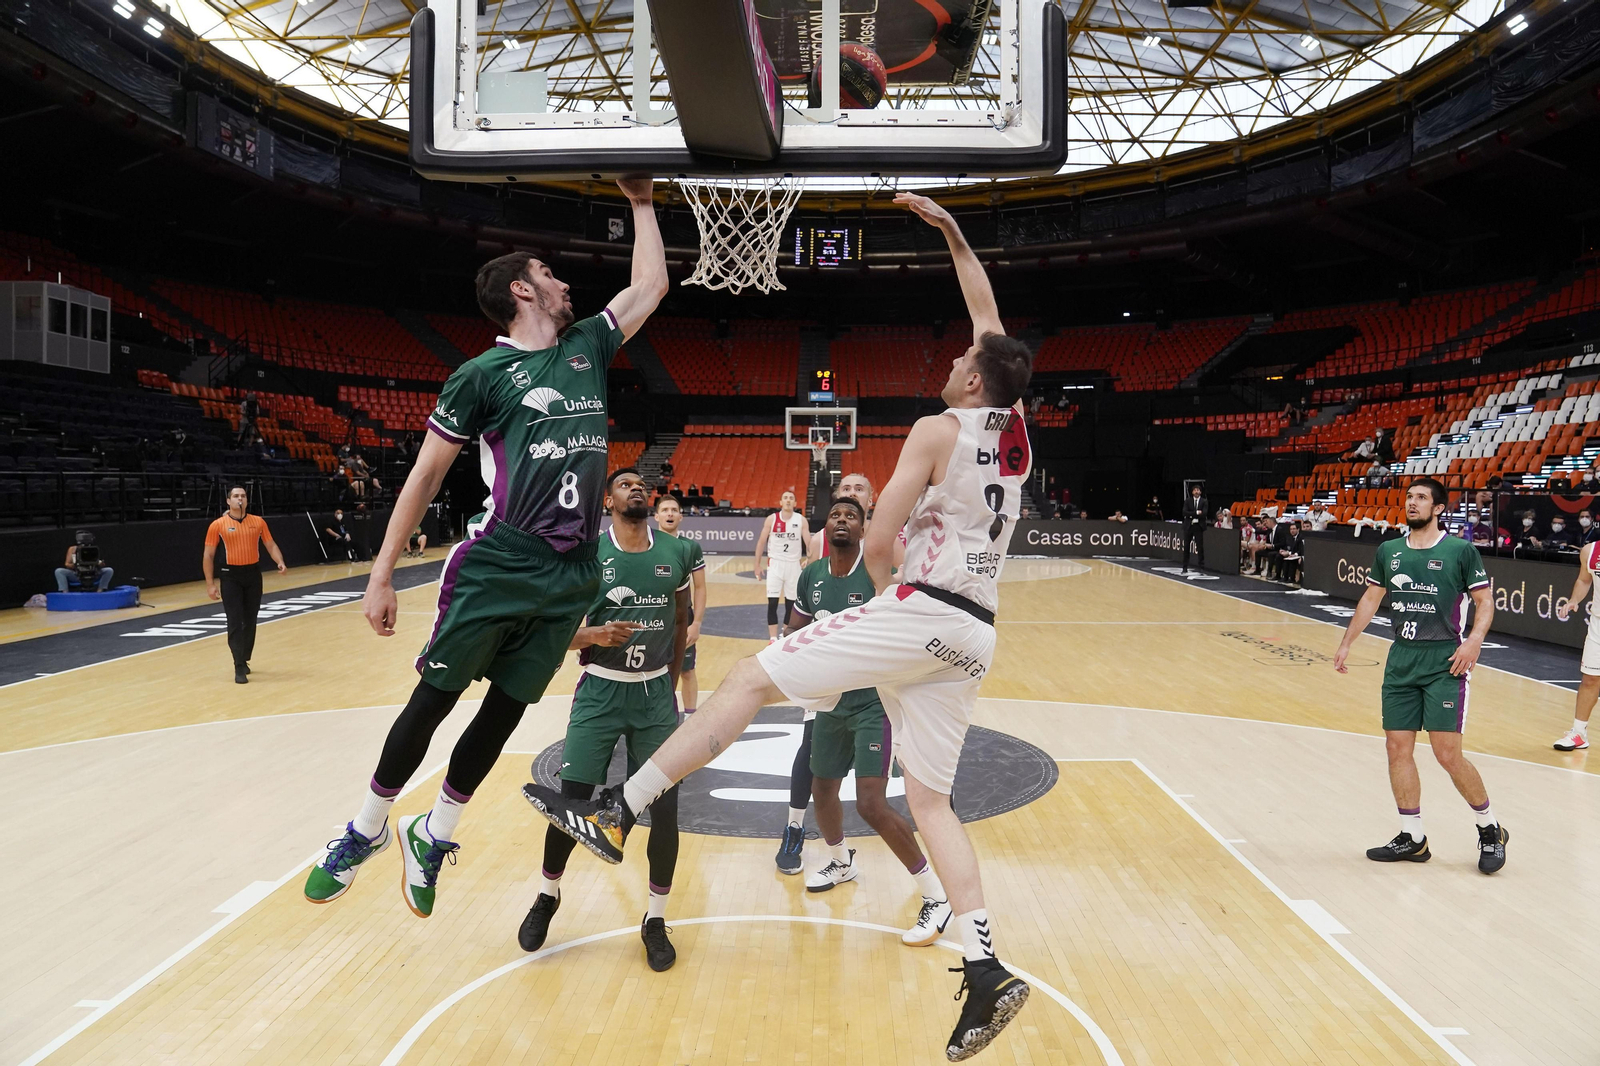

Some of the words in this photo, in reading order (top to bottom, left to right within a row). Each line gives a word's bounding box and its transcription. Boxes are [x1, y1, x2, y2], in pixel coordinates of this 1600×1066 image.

[796, 19, 809, 43] FINAL
[799, 46, 810, 62] FASE
[1583, 344, 1594, 353] 113
[821, 379, 830, 391] 6
[984, 411, 1020, 433] CRUZ
[567, 433, 608, 449] MÁLAGA
[558, 471, 579, 510] 8
[677, 529, 703, 540] nos
[706, 529, 754, 541] mueve
[1027, 529, 1083, 546] Casas
[1090, 532, 1123, 546] con
[1131, 528, 1171, 549] felicidad
[1172, 532, 1181, 551] de
[783, 543, 789, 553] 2
[1410, 582, 1438, 593] Unicaja
[634, 593, 668, 605] Unicaja
[1406, 601, 1436, 611] MÁLAGA
[1536, 584, 1570, 622] de
[1401, 620, 1418, 641] 83
[625, 644, 646, 669] 15
